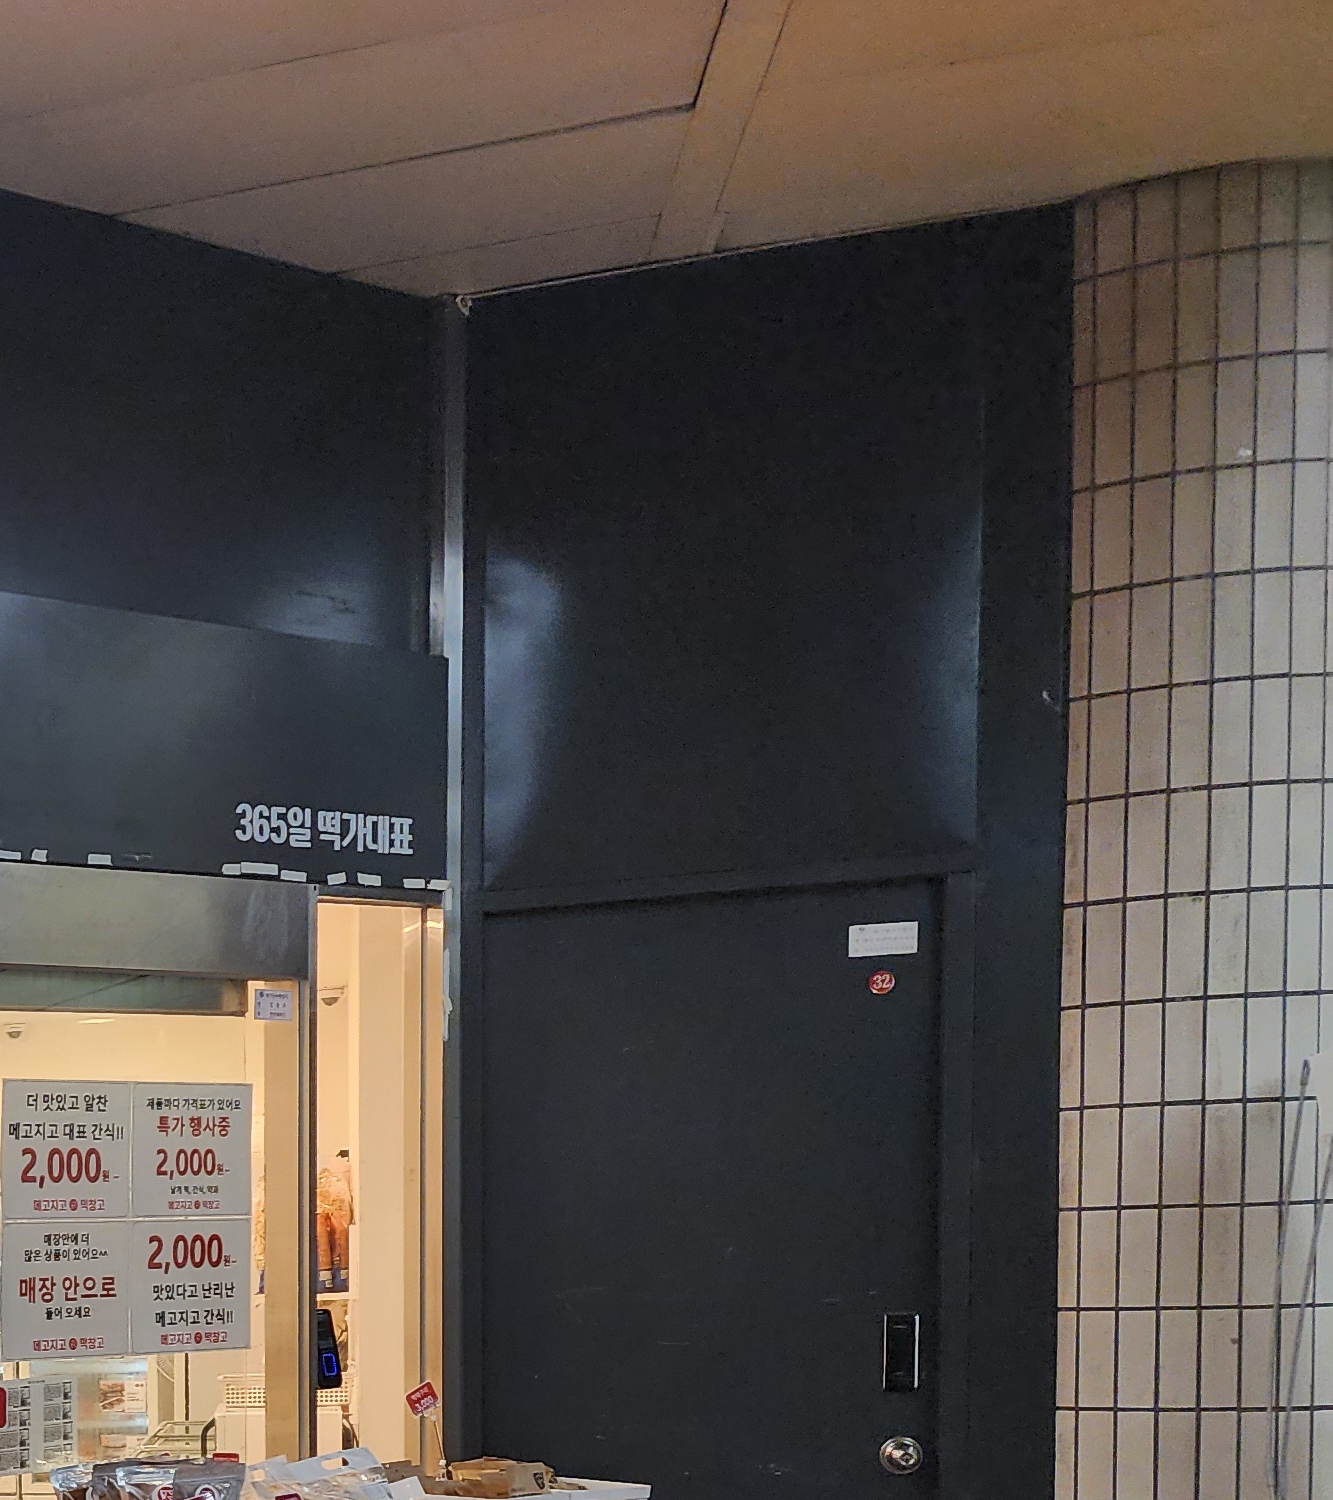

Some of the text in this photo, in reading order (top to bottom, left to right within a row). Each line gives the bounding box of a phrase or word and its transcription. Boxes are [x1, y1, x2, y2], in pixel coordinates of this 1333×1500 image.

[235, 803, 413, 854] 365일 떡가대표
[873, 974, 890, 988] 32
[27, 1093, 108, 1112] 더 맛있고 알찬
[9, 1122, 59, 1141] 메고지고
[63, 1123, 87, 1140] 대표
[157, 1116, 231, 1137] 특가 행사중
[19, 1276, 117, 1303] 매장 안으로
[153, 1282, 235, 1301] 맛있다고 난리난
[45, 1306, 91, 1320] 들어 오세요
[155, 1310, 200, 1327] 메고지고
